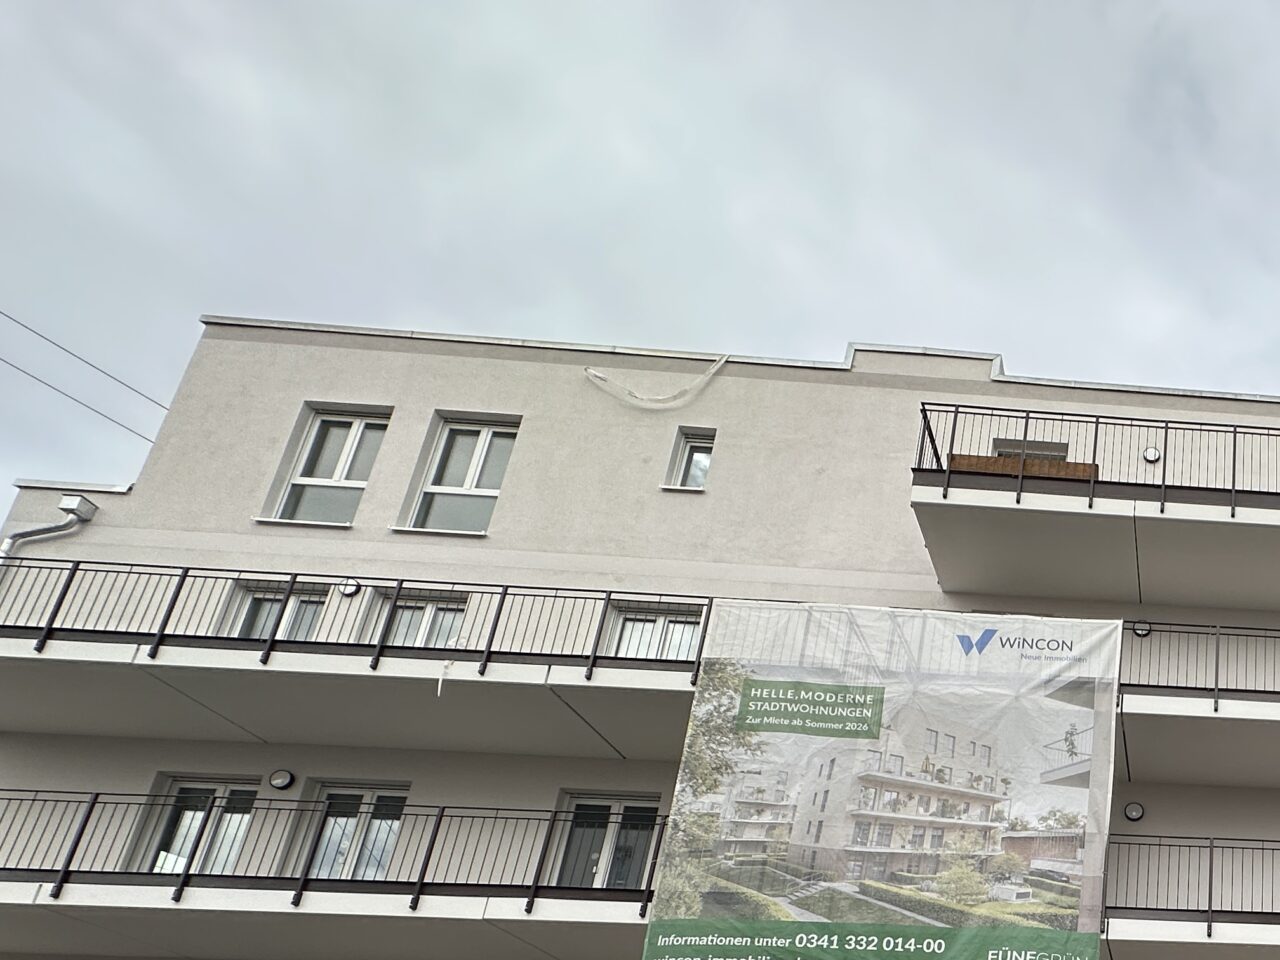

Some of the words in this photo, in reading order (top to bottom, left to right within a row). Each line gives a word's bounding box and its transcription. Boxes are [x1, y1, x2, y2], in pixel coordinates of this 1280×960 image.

[1020, 653, 1041, 661] Neue
[748, 701, 872, 718] STADTWOHNUNGEN
[745, 715, 762, 724] Zur
[763, 716, 790, 726] Miete
[791, 718, 803, 726] ab
[805, 719, 843, 730] Sommer
[845, 722, 869, 731] 2026
[657, 934, 751, 946] Informationen
[754, 935, 792, 947] unter
[795, 933, 839, 949] 0341
[844, 935, 878, 950] 332
[882, 936, 945, 954] 014-00
